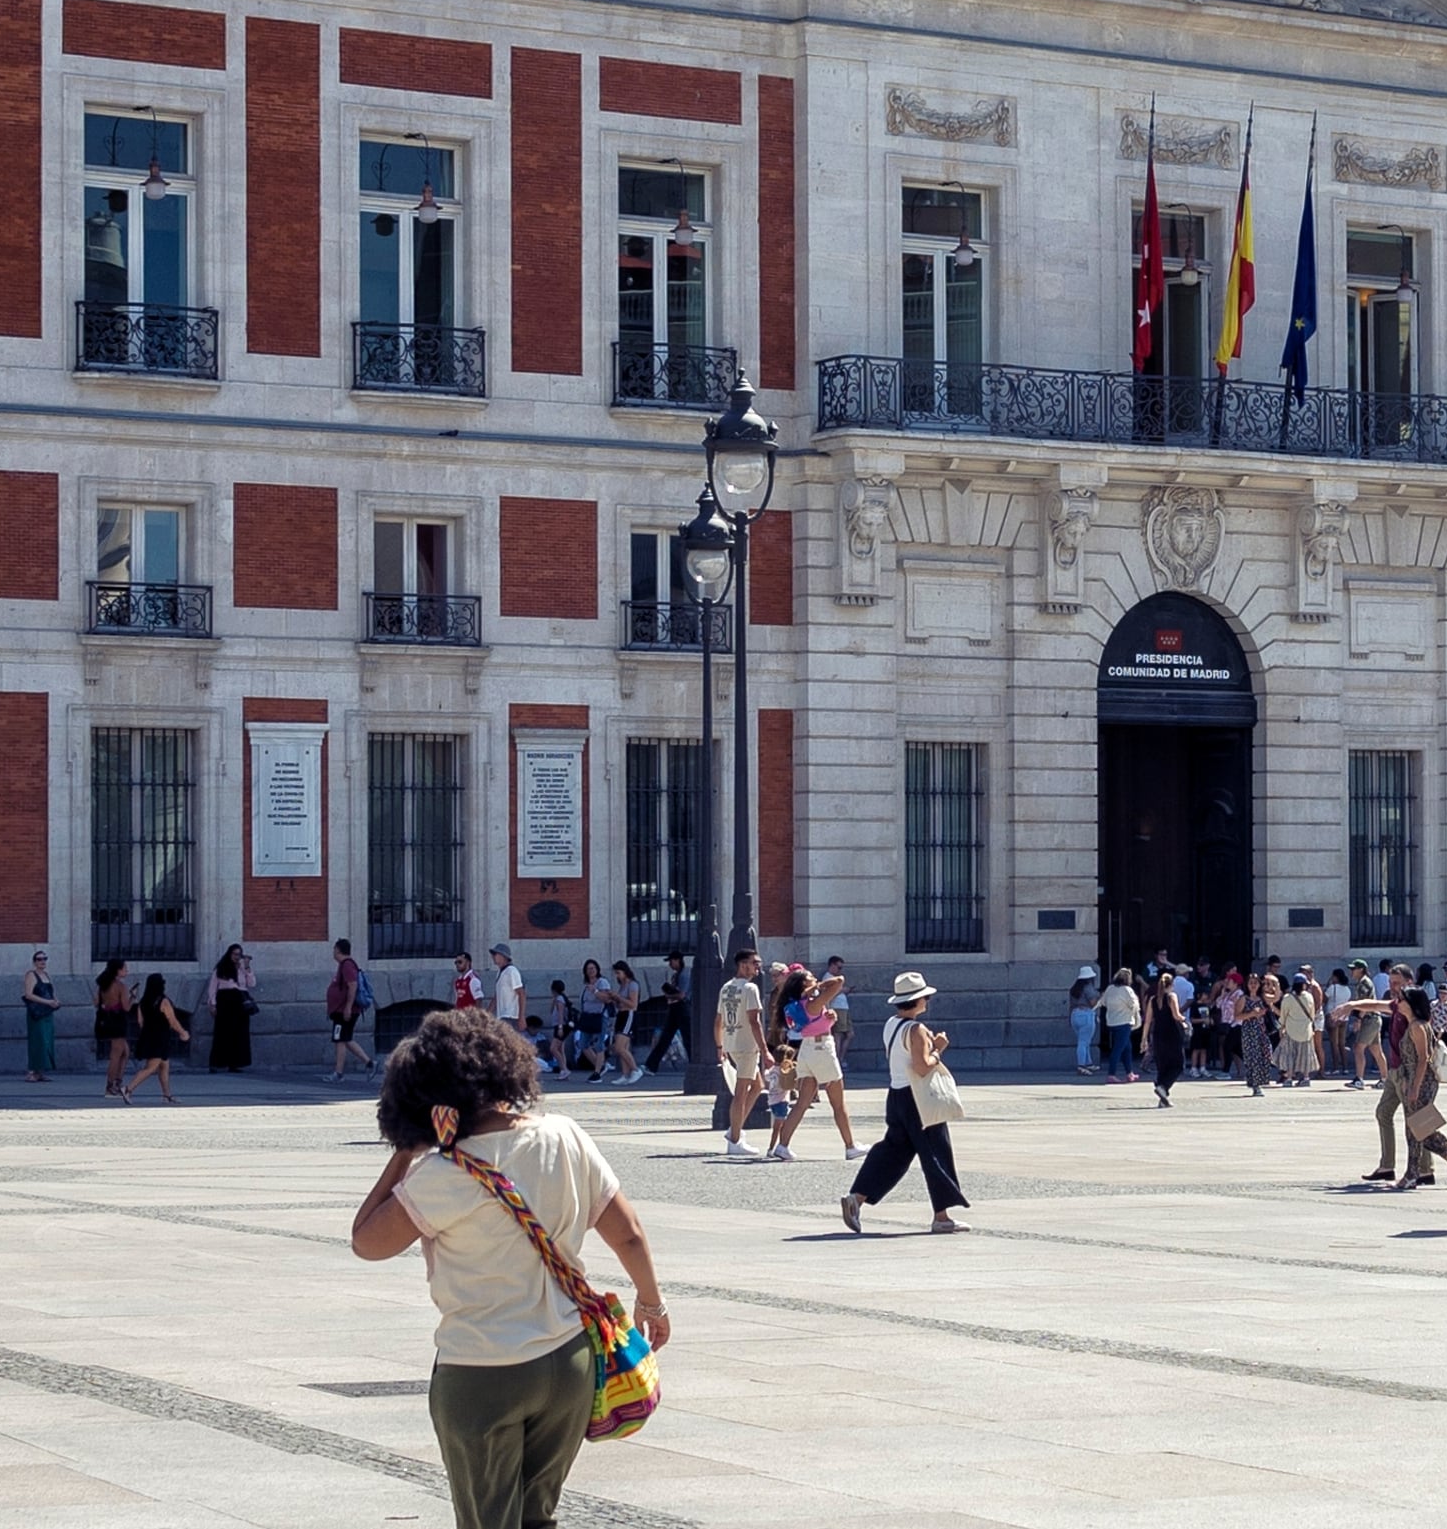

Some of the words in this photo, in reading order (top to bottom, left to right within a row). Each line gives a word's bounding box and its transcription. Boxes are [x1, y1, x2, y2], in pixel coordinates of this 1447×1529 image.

[1136, 653, 1203, 665] PRESIDENCIA
[1108, 666, 1171, 678] COMUNIDAD
[1173, 668, 1188, 678] DE
[1190, 669, 1230, 680] MADRID
